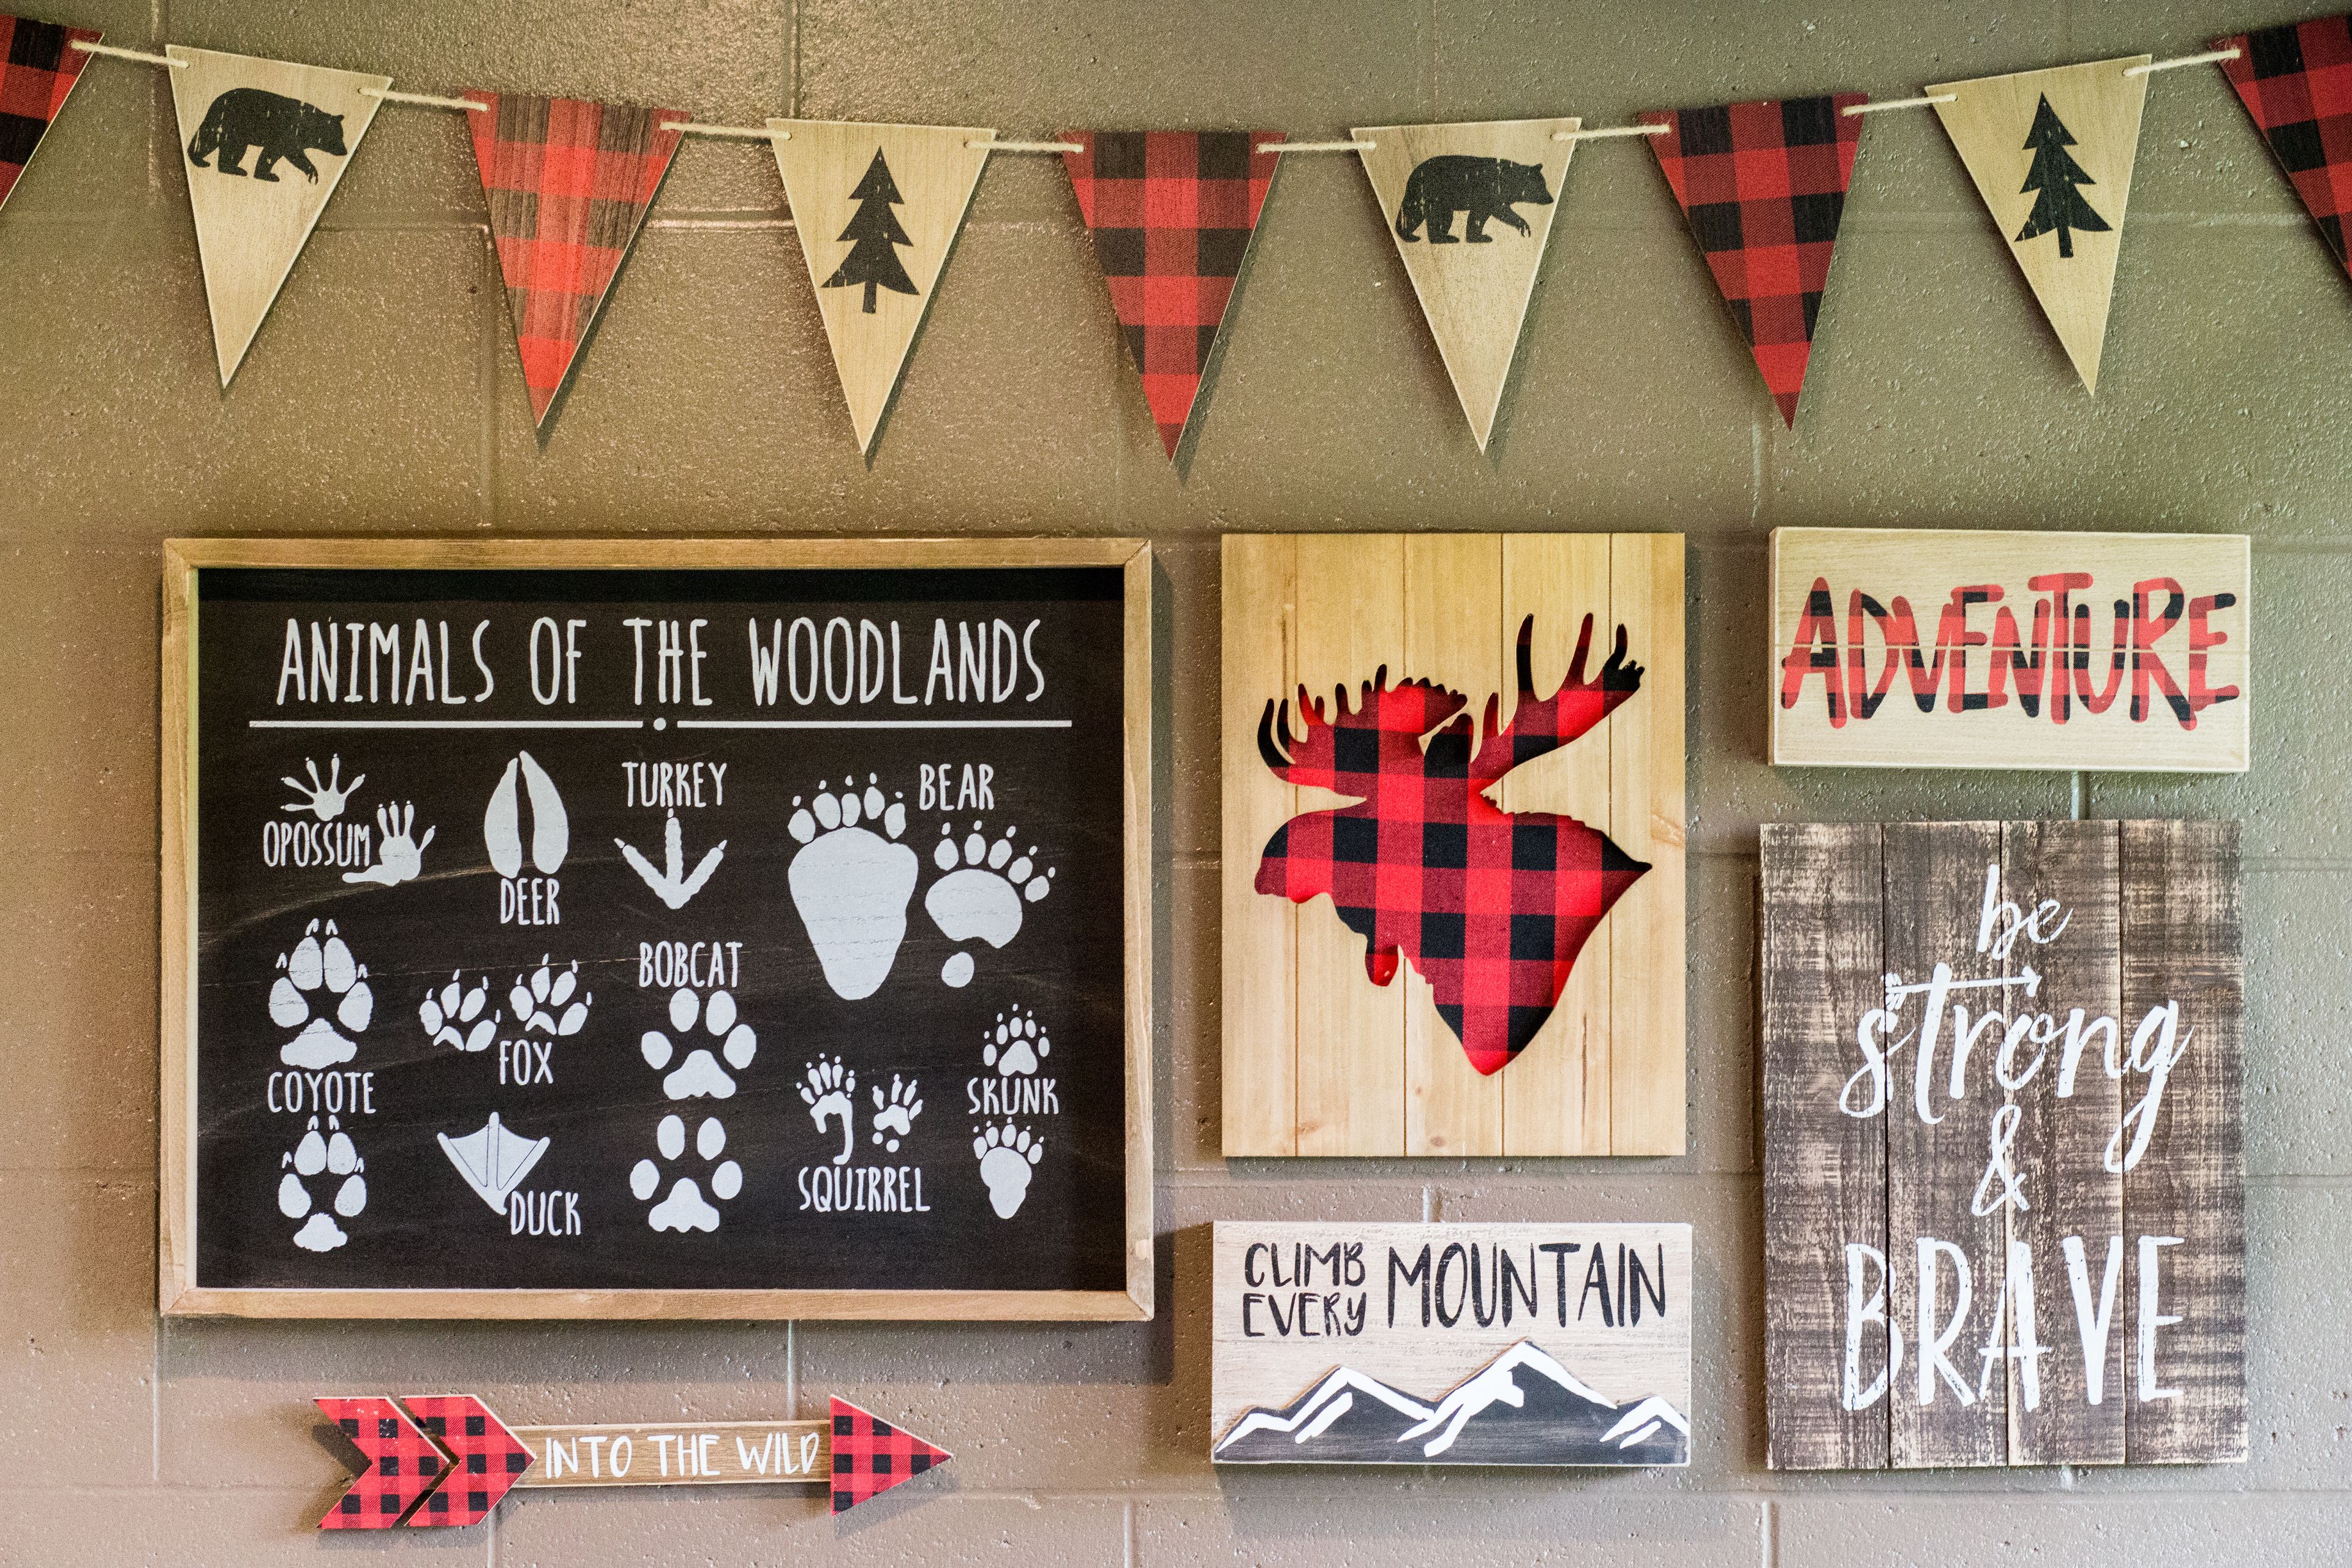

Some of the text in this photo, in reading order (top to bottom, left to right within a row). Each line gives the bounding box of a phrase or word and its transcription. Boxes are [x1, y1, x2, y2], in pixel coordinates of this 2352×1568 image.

[276, 616, 1047, 706] ANIMALS OF THE WOODLANDS
[1781, 572, 2240, 731] ADVENTURE
[622, 761, 727, 809] TURKEY
[919, 763, 995, 811] BEAR
[262, 821, 370, 868] OPOSSUM
[500, 878, 560, 925] DEER
[1977, 864, 2073, 960] be
[639, 941, 744, 988] BOBCAT
[499, 1039, 554, 1085] FOX
[1839, 963, 2195, 1174] strong
[268, 1070, 377, 1115] COYOTE
[967, 1077, 1058, 1116] SKUNK
[1971, 1104, 2030, 1216] &
[799, 1164, 931, 1213] SQUIRREL
[510, 1190, 581, 1236] DUCK
[1244, 1242, 1366, 1288] CLIMB
[1387, 1242, 1666, 1329] MOUNTAIN
[1243, 1292, 1367, 1338] EVERY
[1842, 1235, 2185, 1411] BRAVE
[545, 1433, 820, 1479] INTO THE WILD
